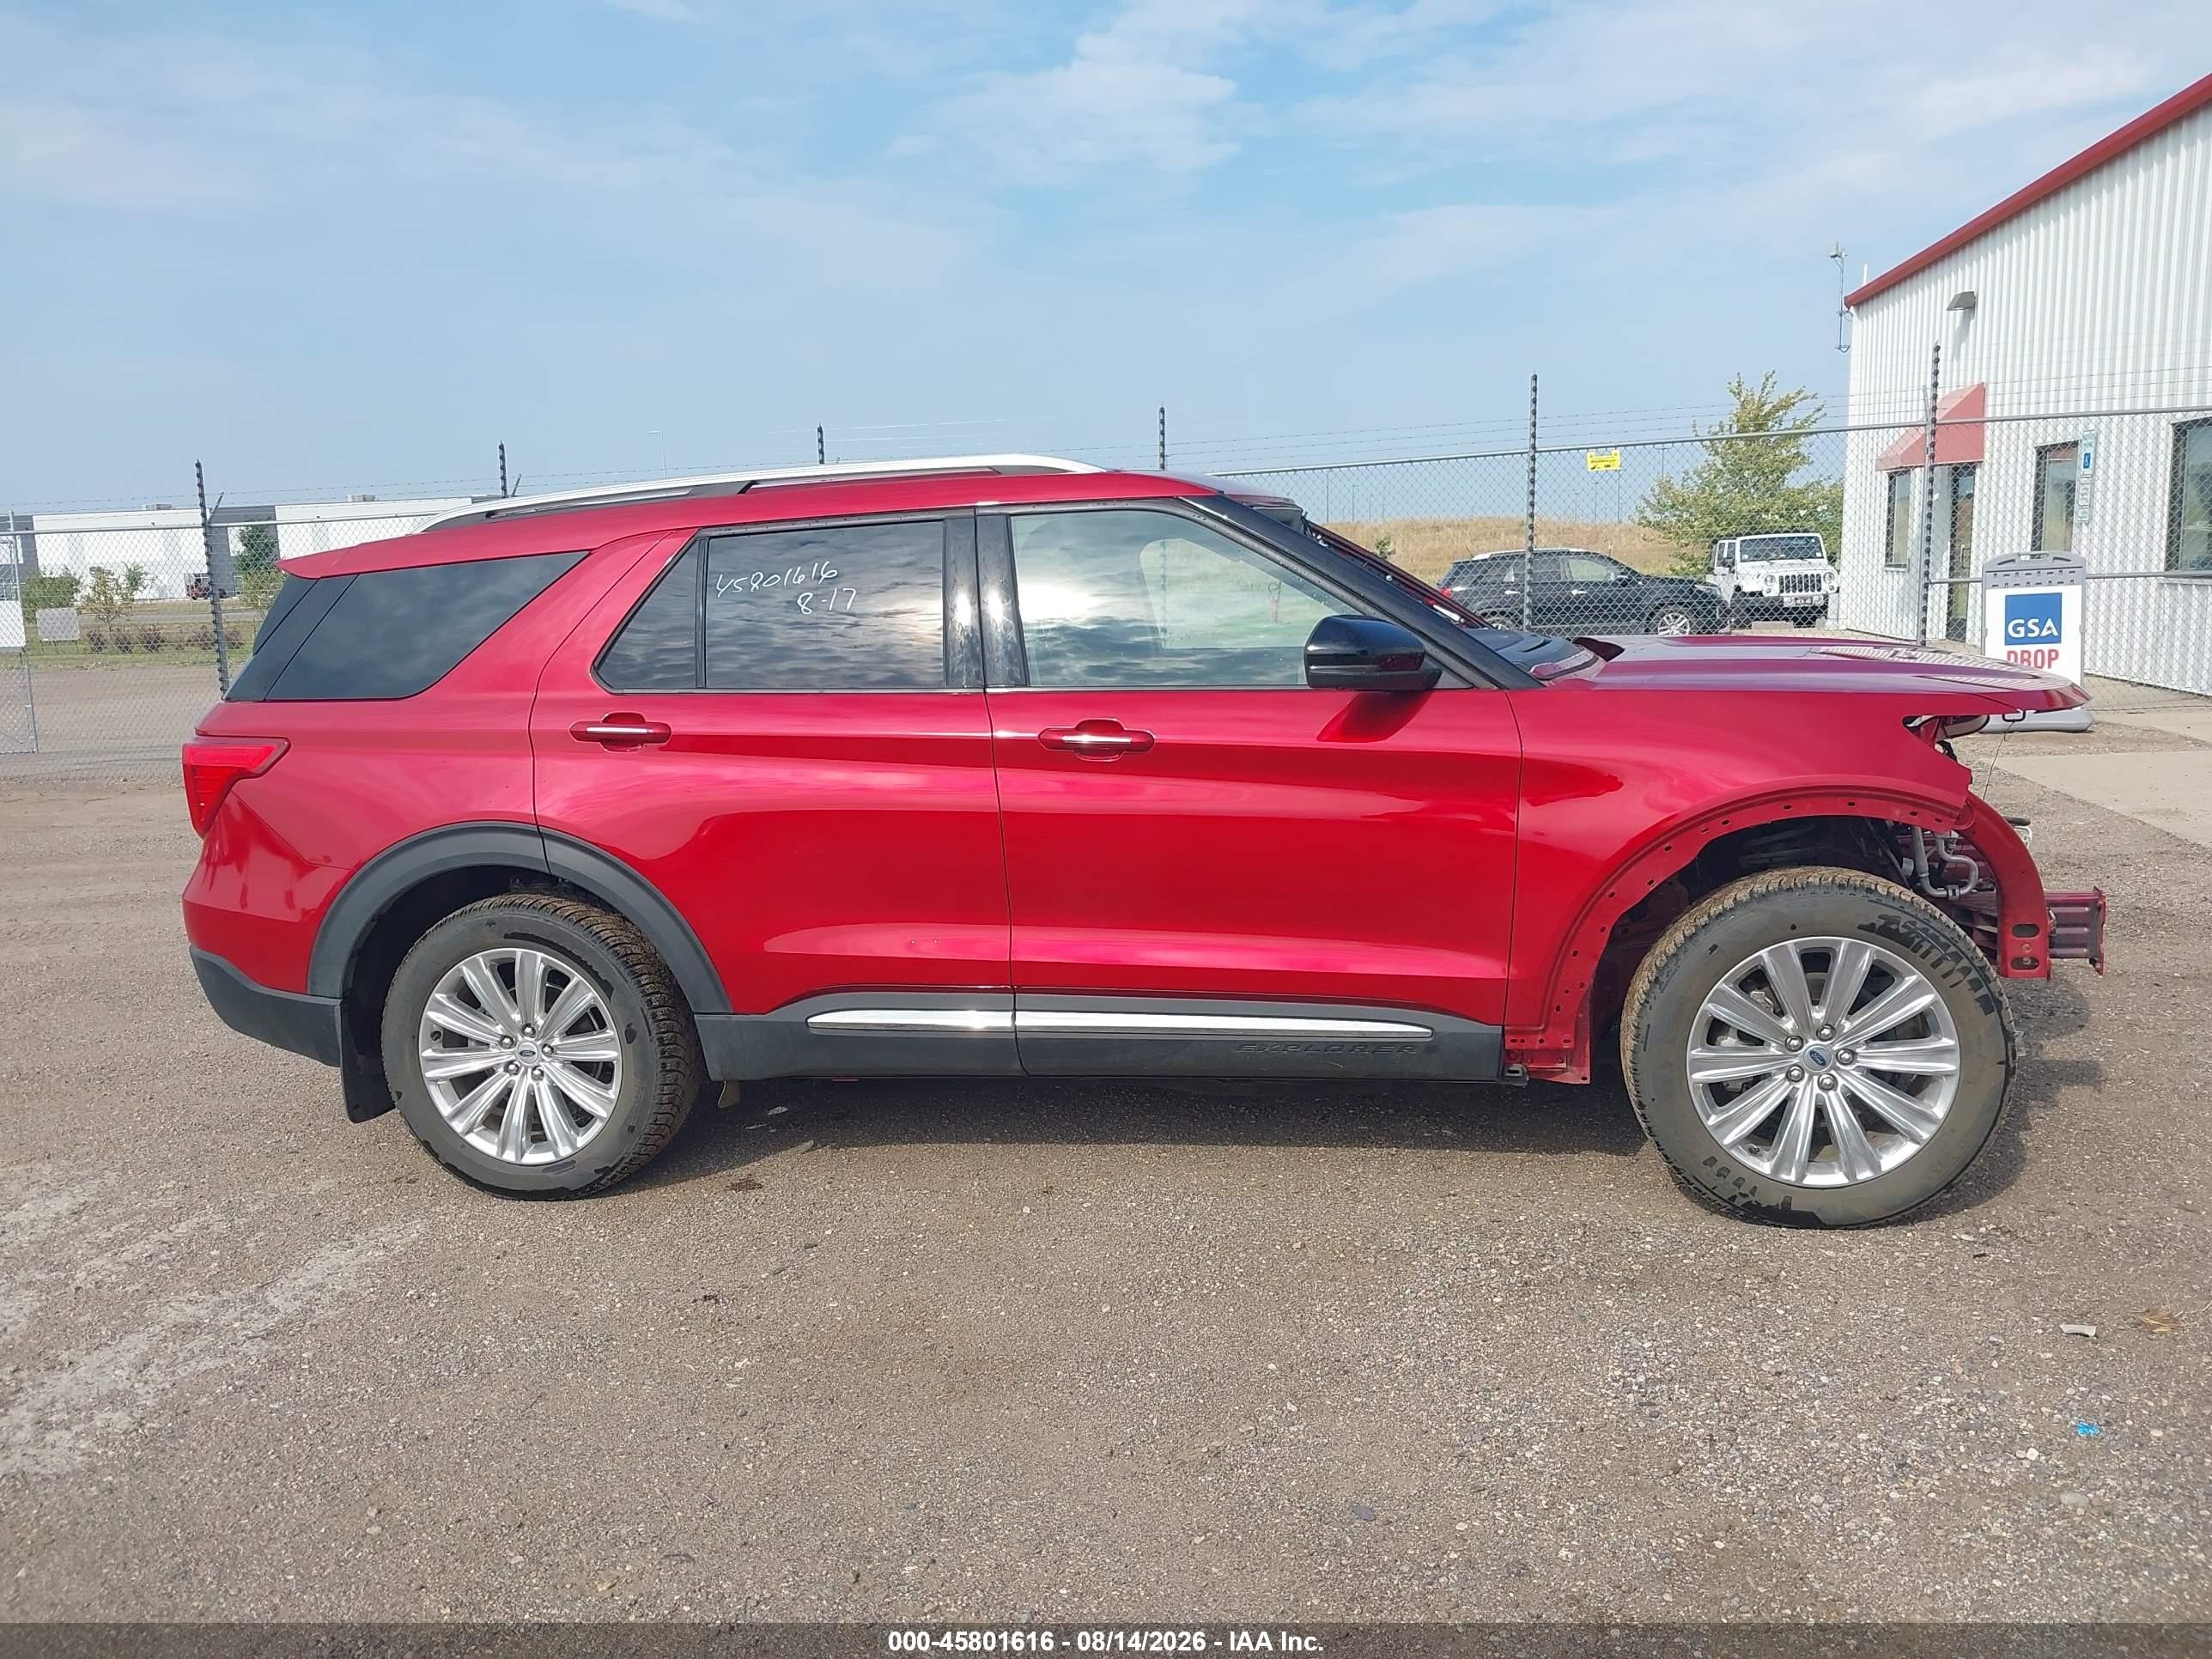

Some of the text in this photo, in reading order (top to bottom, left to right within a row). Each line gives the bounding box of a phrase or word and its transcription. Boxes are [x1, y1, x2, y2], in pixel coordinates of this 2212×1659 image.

[796, 587, 858, 616] 8-17
[2008, 617, 2059, 639] GSA
[1235, 1042, 1419, 1055] EXPLORER
